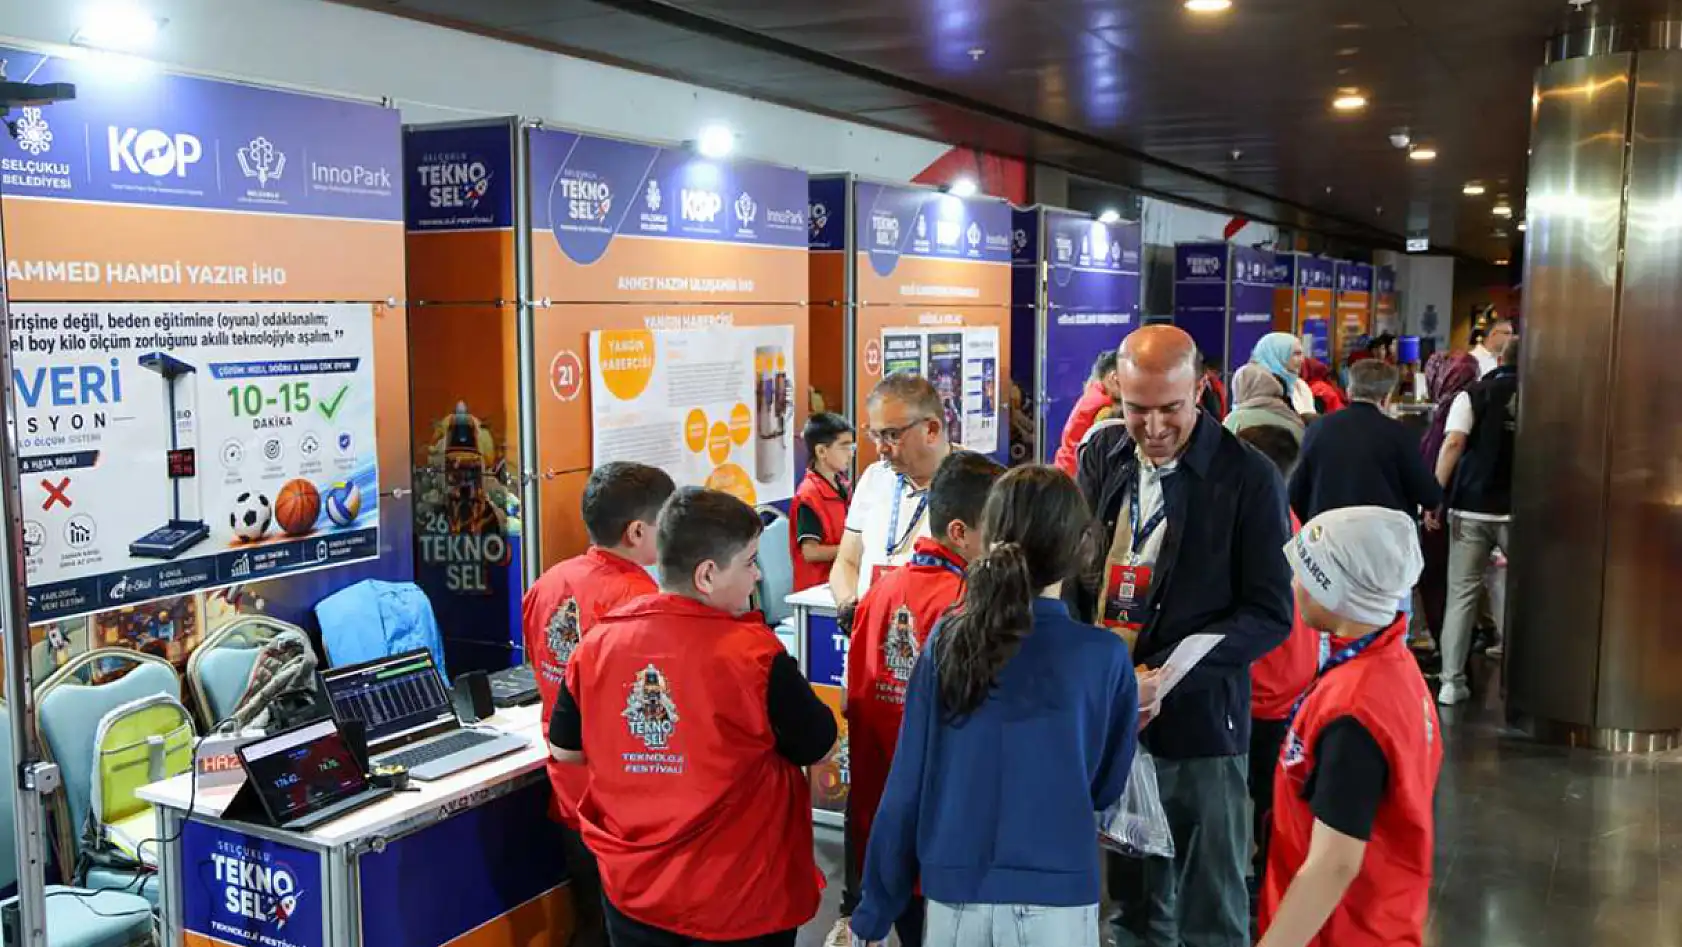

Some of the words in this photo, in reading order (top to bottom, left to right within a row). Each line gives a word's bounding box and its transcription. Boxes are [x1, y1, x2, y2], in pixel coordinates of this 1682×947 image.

[108, 125, 202, 178] KOP
[1, 159, 69, 176] SELÇUKLU
[311, 161, 392, 188] InnoPark
[417, 162, 486, 187] TEKNO
[2, 173, 71, 189] BELEDİYESİ
[560, 178, 609, 200] TEKNO
[429, 186, 464, 208] SEL
[568, 199, 594, 219] SEL
[106, 261, 181, 285] HAMDİ
[186, 264, 248, 285] YAZIR
[252, 260, 287, 285] İHO
[63, 312, 104, 332] değil,
[107, 312, 154, 328] beden
[154, 311, 214, 331] eğitimine
[217, 311, 260, 330] (oyuna)
[262, 311, 330, 327] odaklanalım;
[10, 335, 24, 351] el
[28, 334, 56, 354] boy
[60, 333, 86, 350] kilo
[90, 333, 131, 352] ölçüm
[135, 332, 198, 351] zorluğunu
[201, 331, 229, 346] akıllı
[231, 329, 295, 347] teknolojiyle
[558, 365, 573, 386] 21
[227, 382, 312, 417] 10-15
[252, 415, 293, 430] DAKİKA
[426, 510, 449, 534] 26
[419, 533, 504, 563] TEKNO
[446, 564, 487, 590] SEL
[629, 720, 671, 734] TEKNO
[644, 733, 667, 746] SEL
[217, 841, 272, 863] SELÇUKLU
[210, 852, 294, 897] TEKNO
[225, 885, 268, 922] SEL
[211, 921, 259, 941] TEKNOLOJİ
